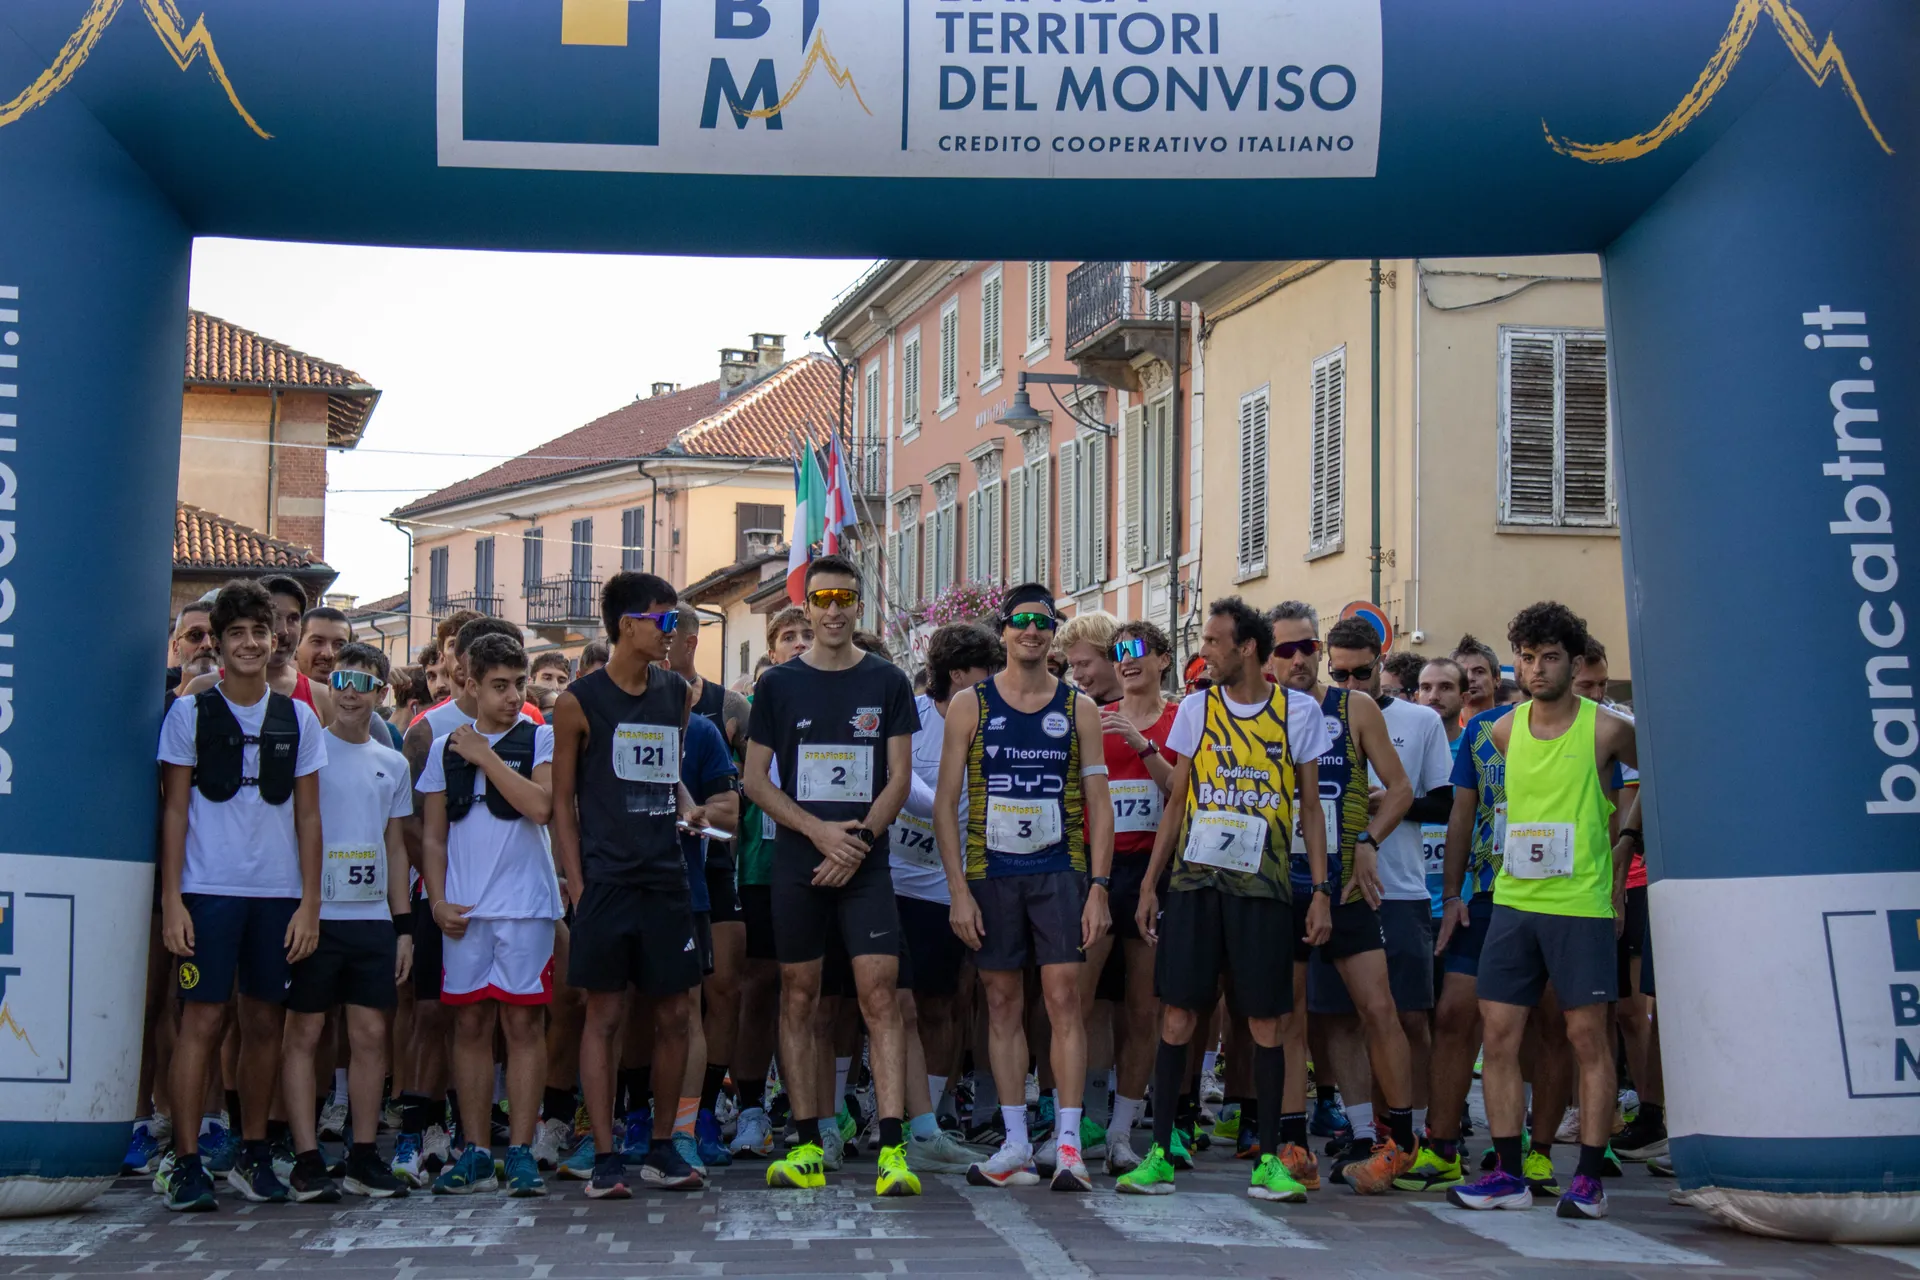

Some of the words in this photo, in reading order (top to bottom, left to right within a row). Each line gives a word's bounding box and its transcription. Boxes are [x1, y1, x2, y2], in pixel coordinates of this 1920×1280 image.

[935, 11, 1219, 55] TERRITORI
[699, 58, 784, 130] M
[938, 65, 1038, 111] DEL
[1055, 64, 1357, 112] MONVISO
[938, 135, 1042, 152] CREDITO
[1051, 135, 1228, 153] COOPERATIVO
[1238, 134, 1355, 152] ITALIANO
[1803, 305, 1920, 814] bancabtm.it
[633, 745, 664, 767] 121
[1003, 747, 1067, 760] Theorema
[831, 766, 846, 785] 2
[1216, 766, 1270, 780] Podistica
[988, 774, 1063, 793] BYD
[1198, 783, 1280, 810] Bairese
[1114, 799, 1151, 817] 173
[1018, 821, 1032, 838] 3
[900, 827, 935, 854] 174
[1219, 832, 1236, 851] 7
[1530, 843, 1544, 863] 5
[348, 865, 376, 885] 53
